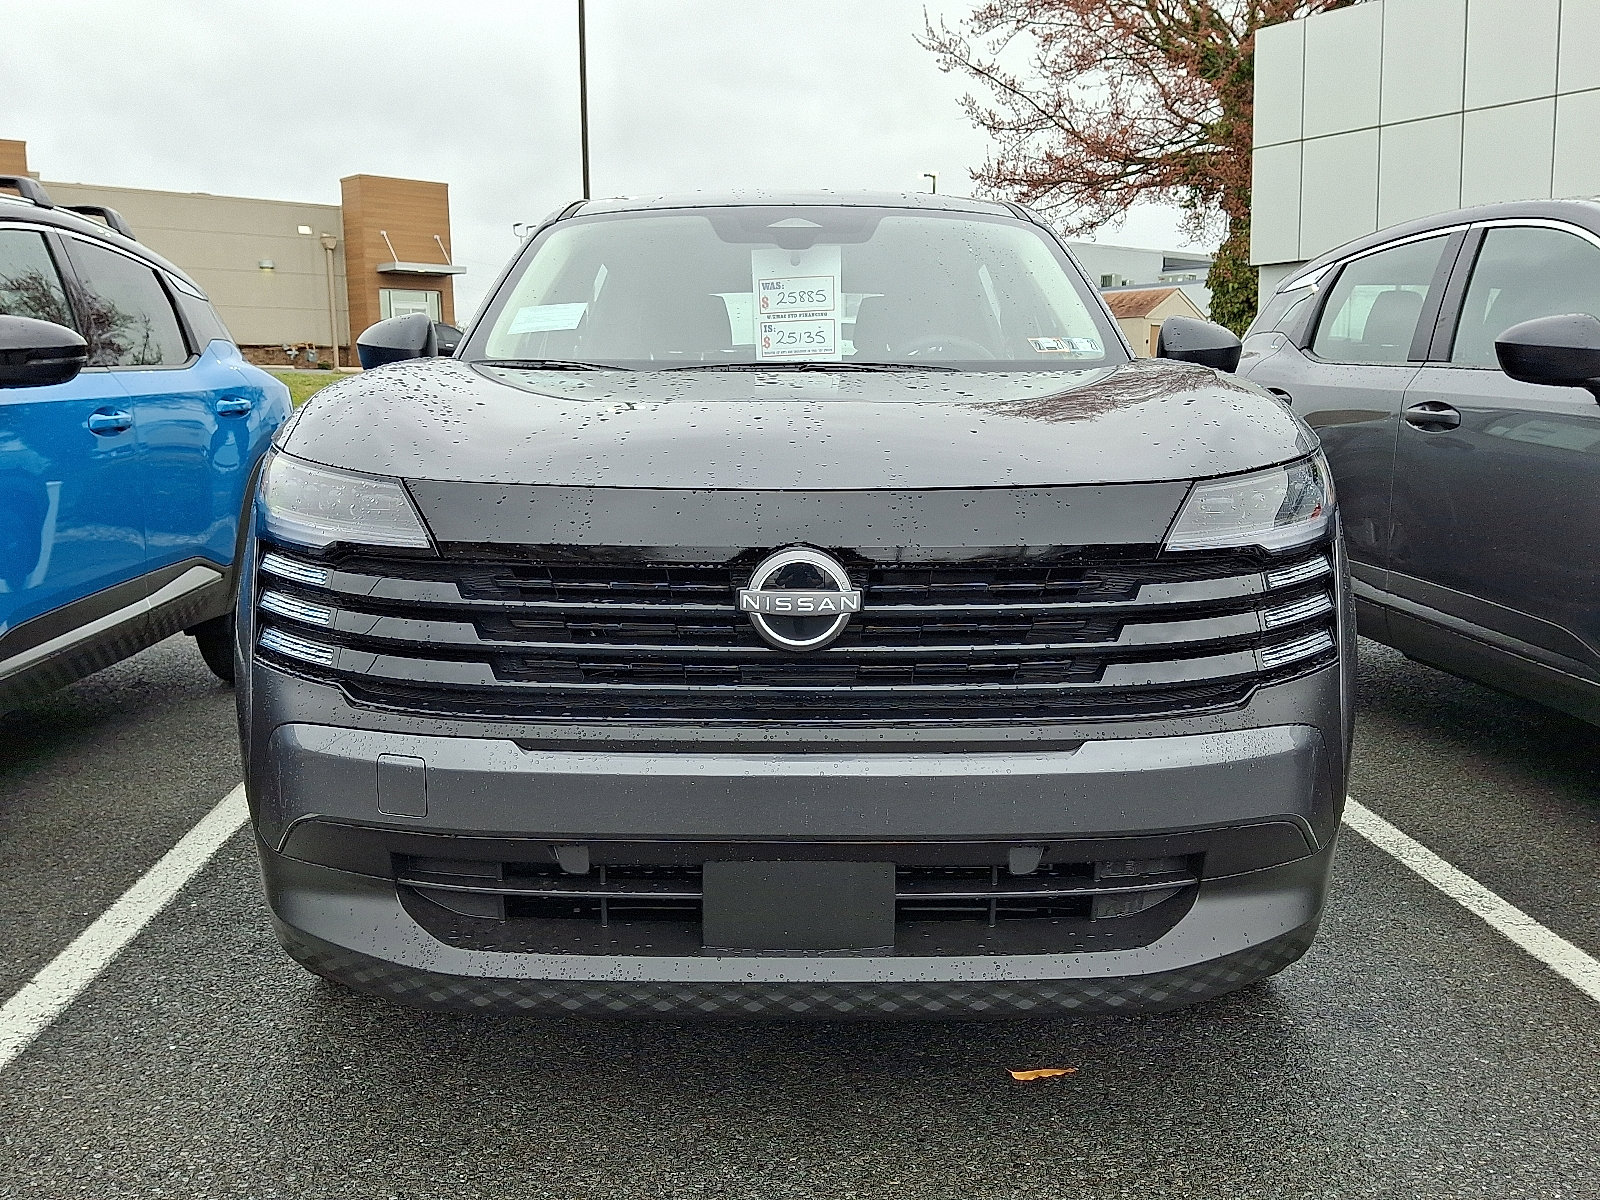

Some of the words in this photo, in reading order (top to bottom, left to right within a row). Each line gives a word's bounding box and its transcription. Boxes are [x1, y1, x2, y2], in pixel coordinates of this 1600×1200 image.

[761, 282, 785, 290] WAS:
[761, 295, 769, 310] $
[776, 289, 827, 306] 25885
[763, 325, 776, 333] IS:
[762, 335, 771, 349] $
[776, 330, 826, 345] 25135
[742, 594, 857, 612] NISSAN
